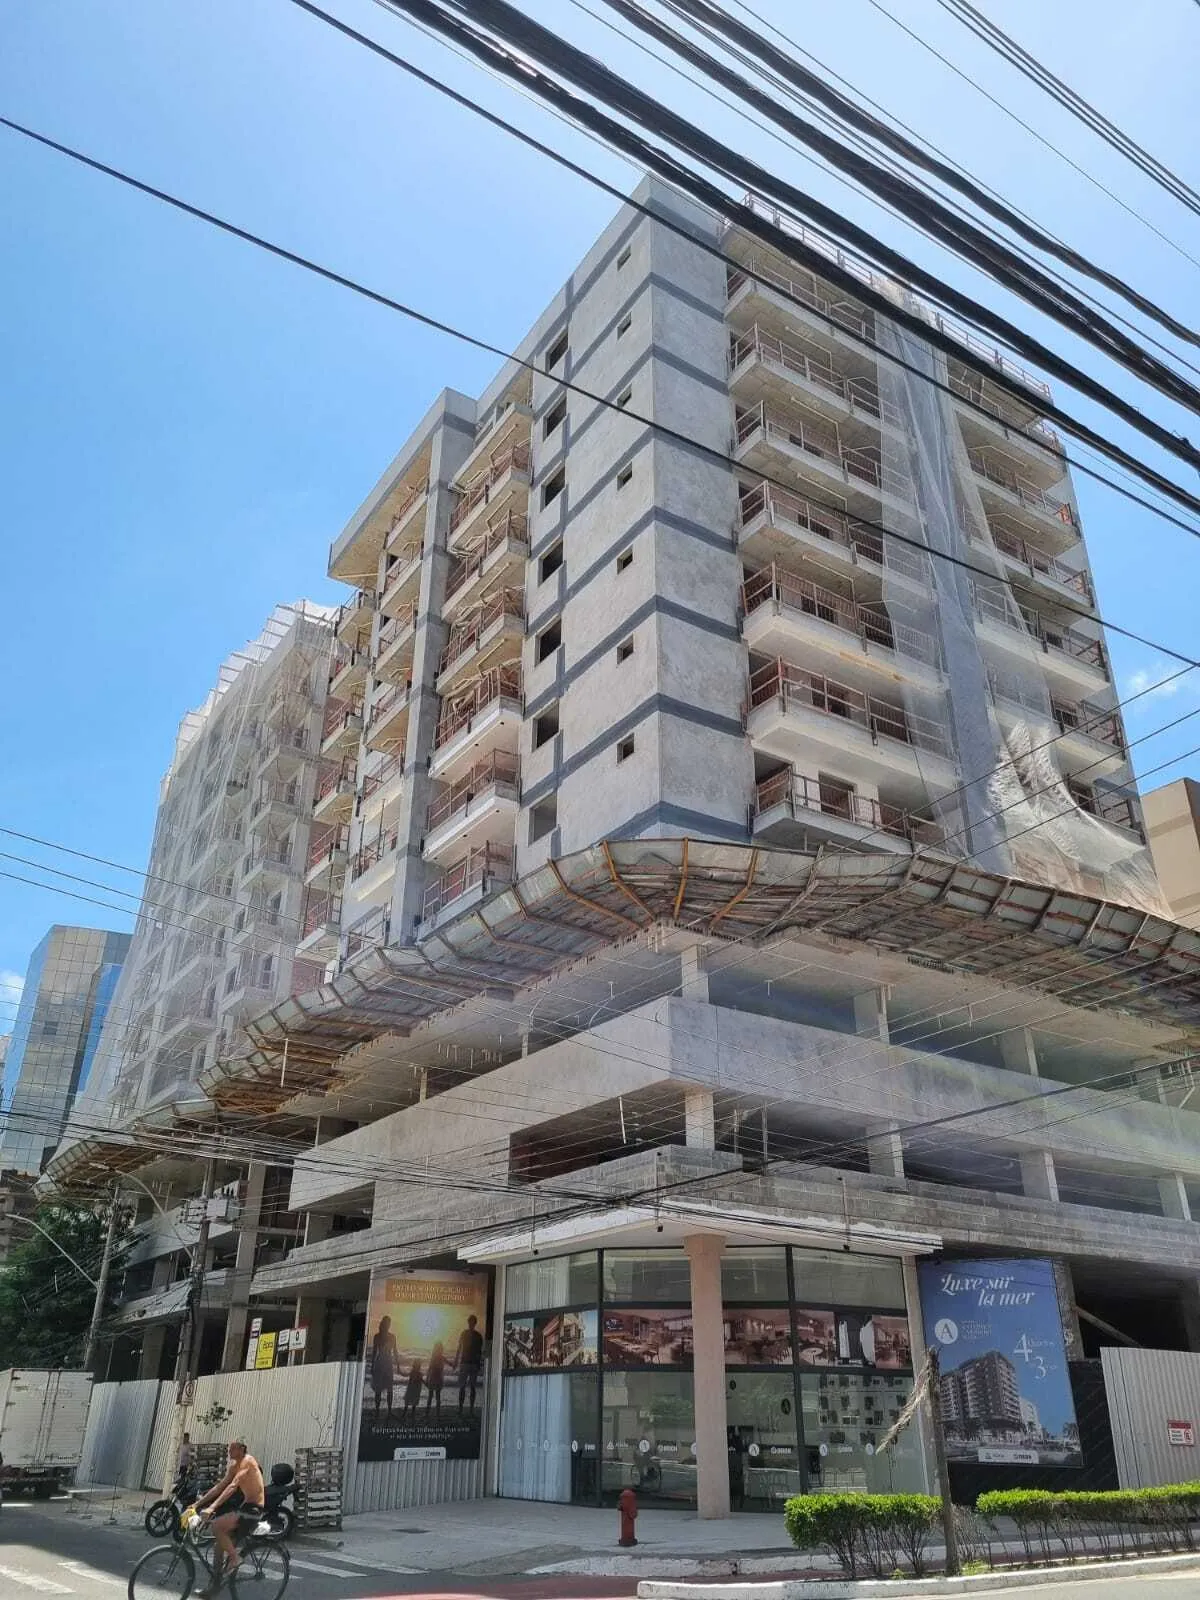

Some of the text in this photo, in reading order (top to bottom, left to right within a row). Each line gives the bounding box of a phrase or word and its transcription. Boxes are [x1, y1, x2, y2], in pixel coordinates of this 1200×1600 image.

[941, 1273, 1014, 1296] Luxe sur
[978, 1289, 1036, 1307] la mer
[1013, 1334, 1033, 1362] 4
[1034, 1356, 1047, 1379] 3
